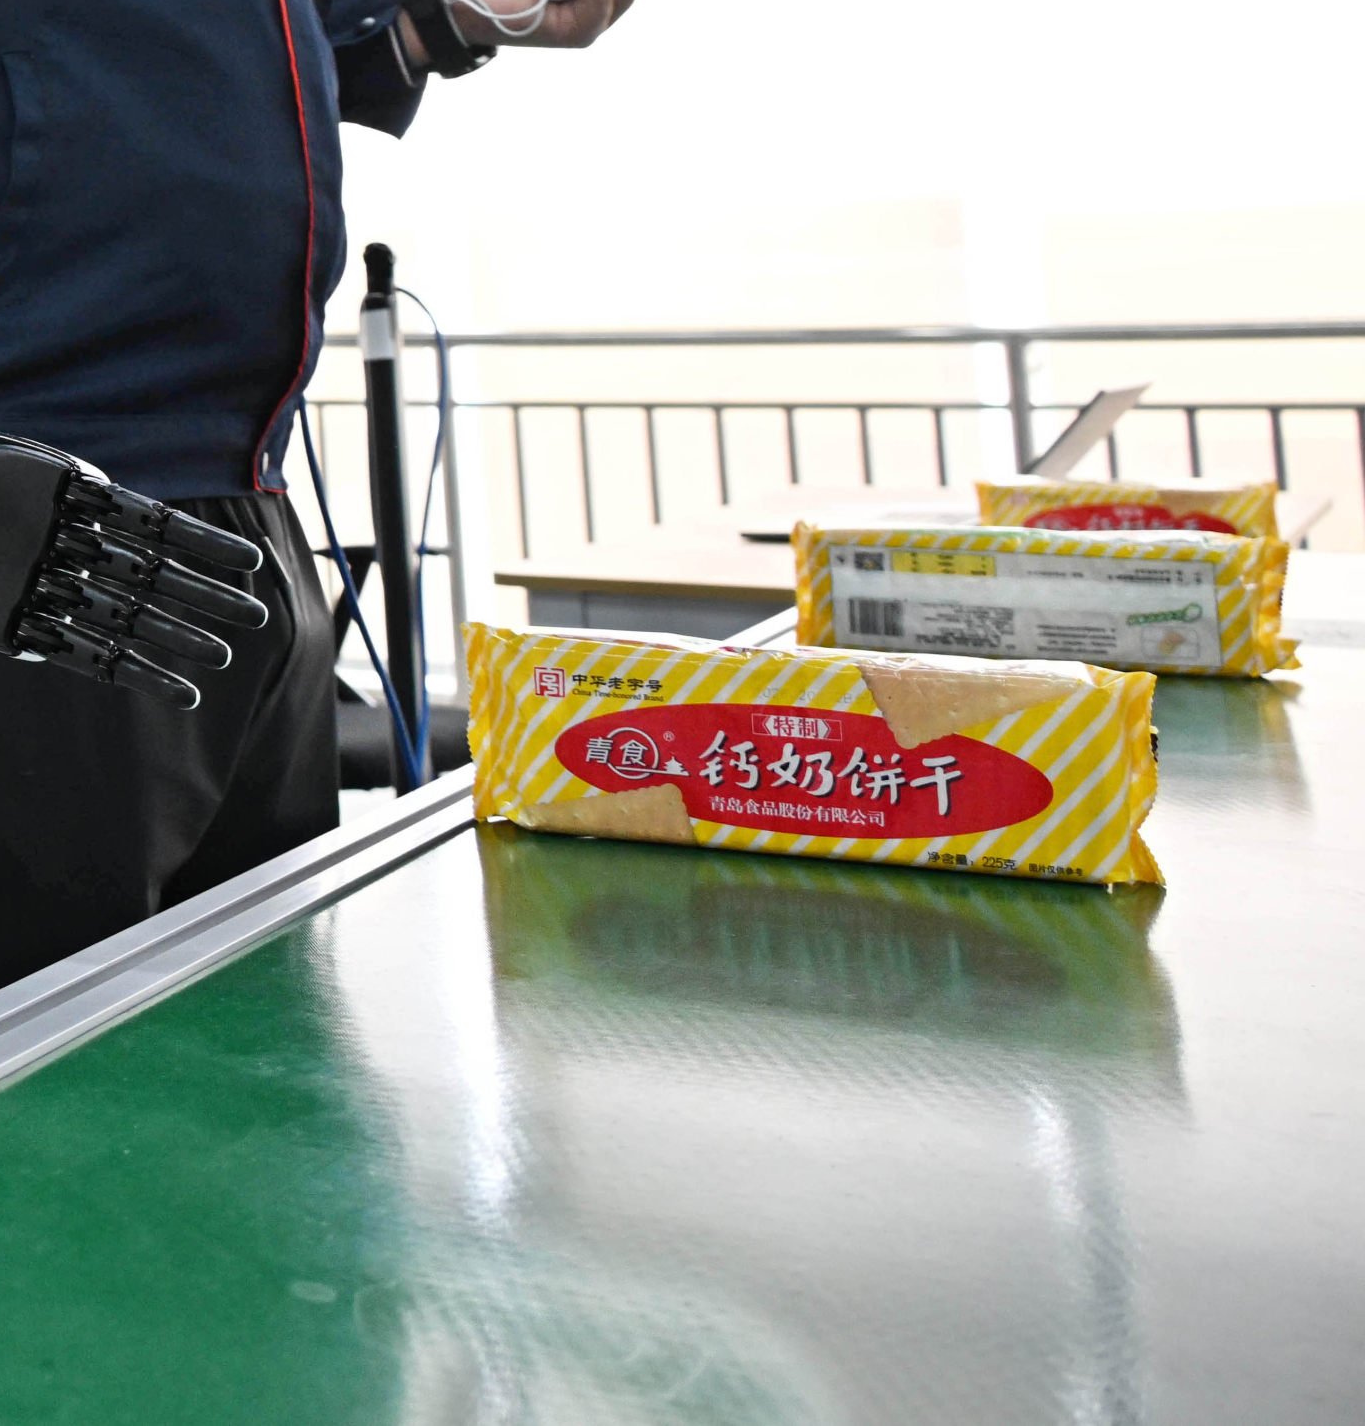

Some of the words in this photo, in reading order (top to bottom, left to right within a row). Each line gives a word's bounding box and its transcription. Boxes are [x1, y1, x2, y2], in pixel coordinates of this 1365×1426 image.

[572, 674, 663, 692] 中华老字号
[773, 716, 818, 738] 特制
[585, 737, 648, 767] 青食
[698, 730, 963, 816] 钙奶饼干
[708, 795, 885, 827] 青岛食品股份有限公司
